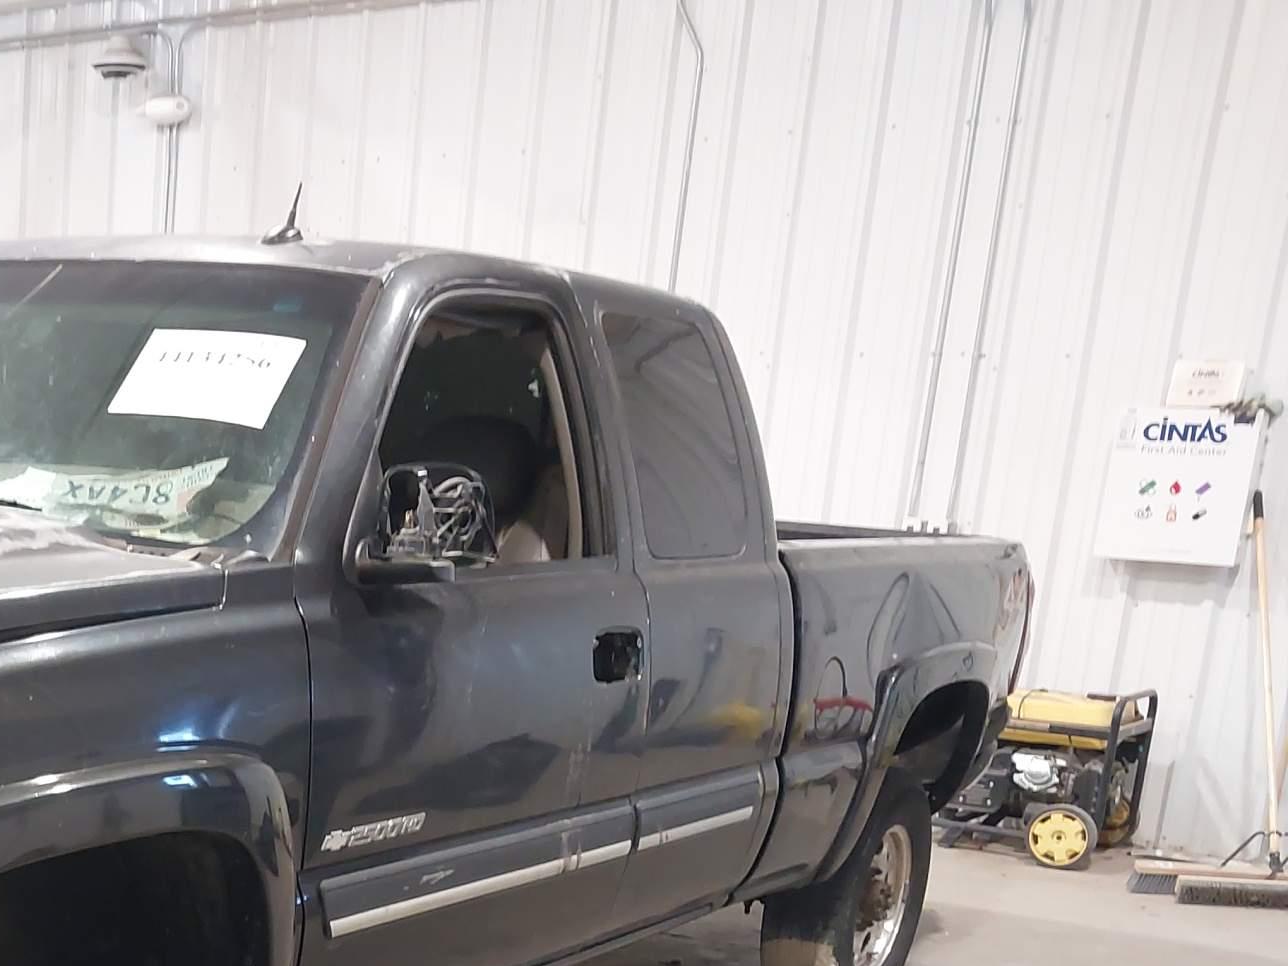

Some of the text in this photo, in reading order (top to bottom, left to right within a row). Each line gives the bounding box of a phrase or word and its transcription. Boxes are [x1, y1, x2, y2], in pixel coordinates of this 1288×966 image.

[1141, 444, 1227, 456] First Aid Center
